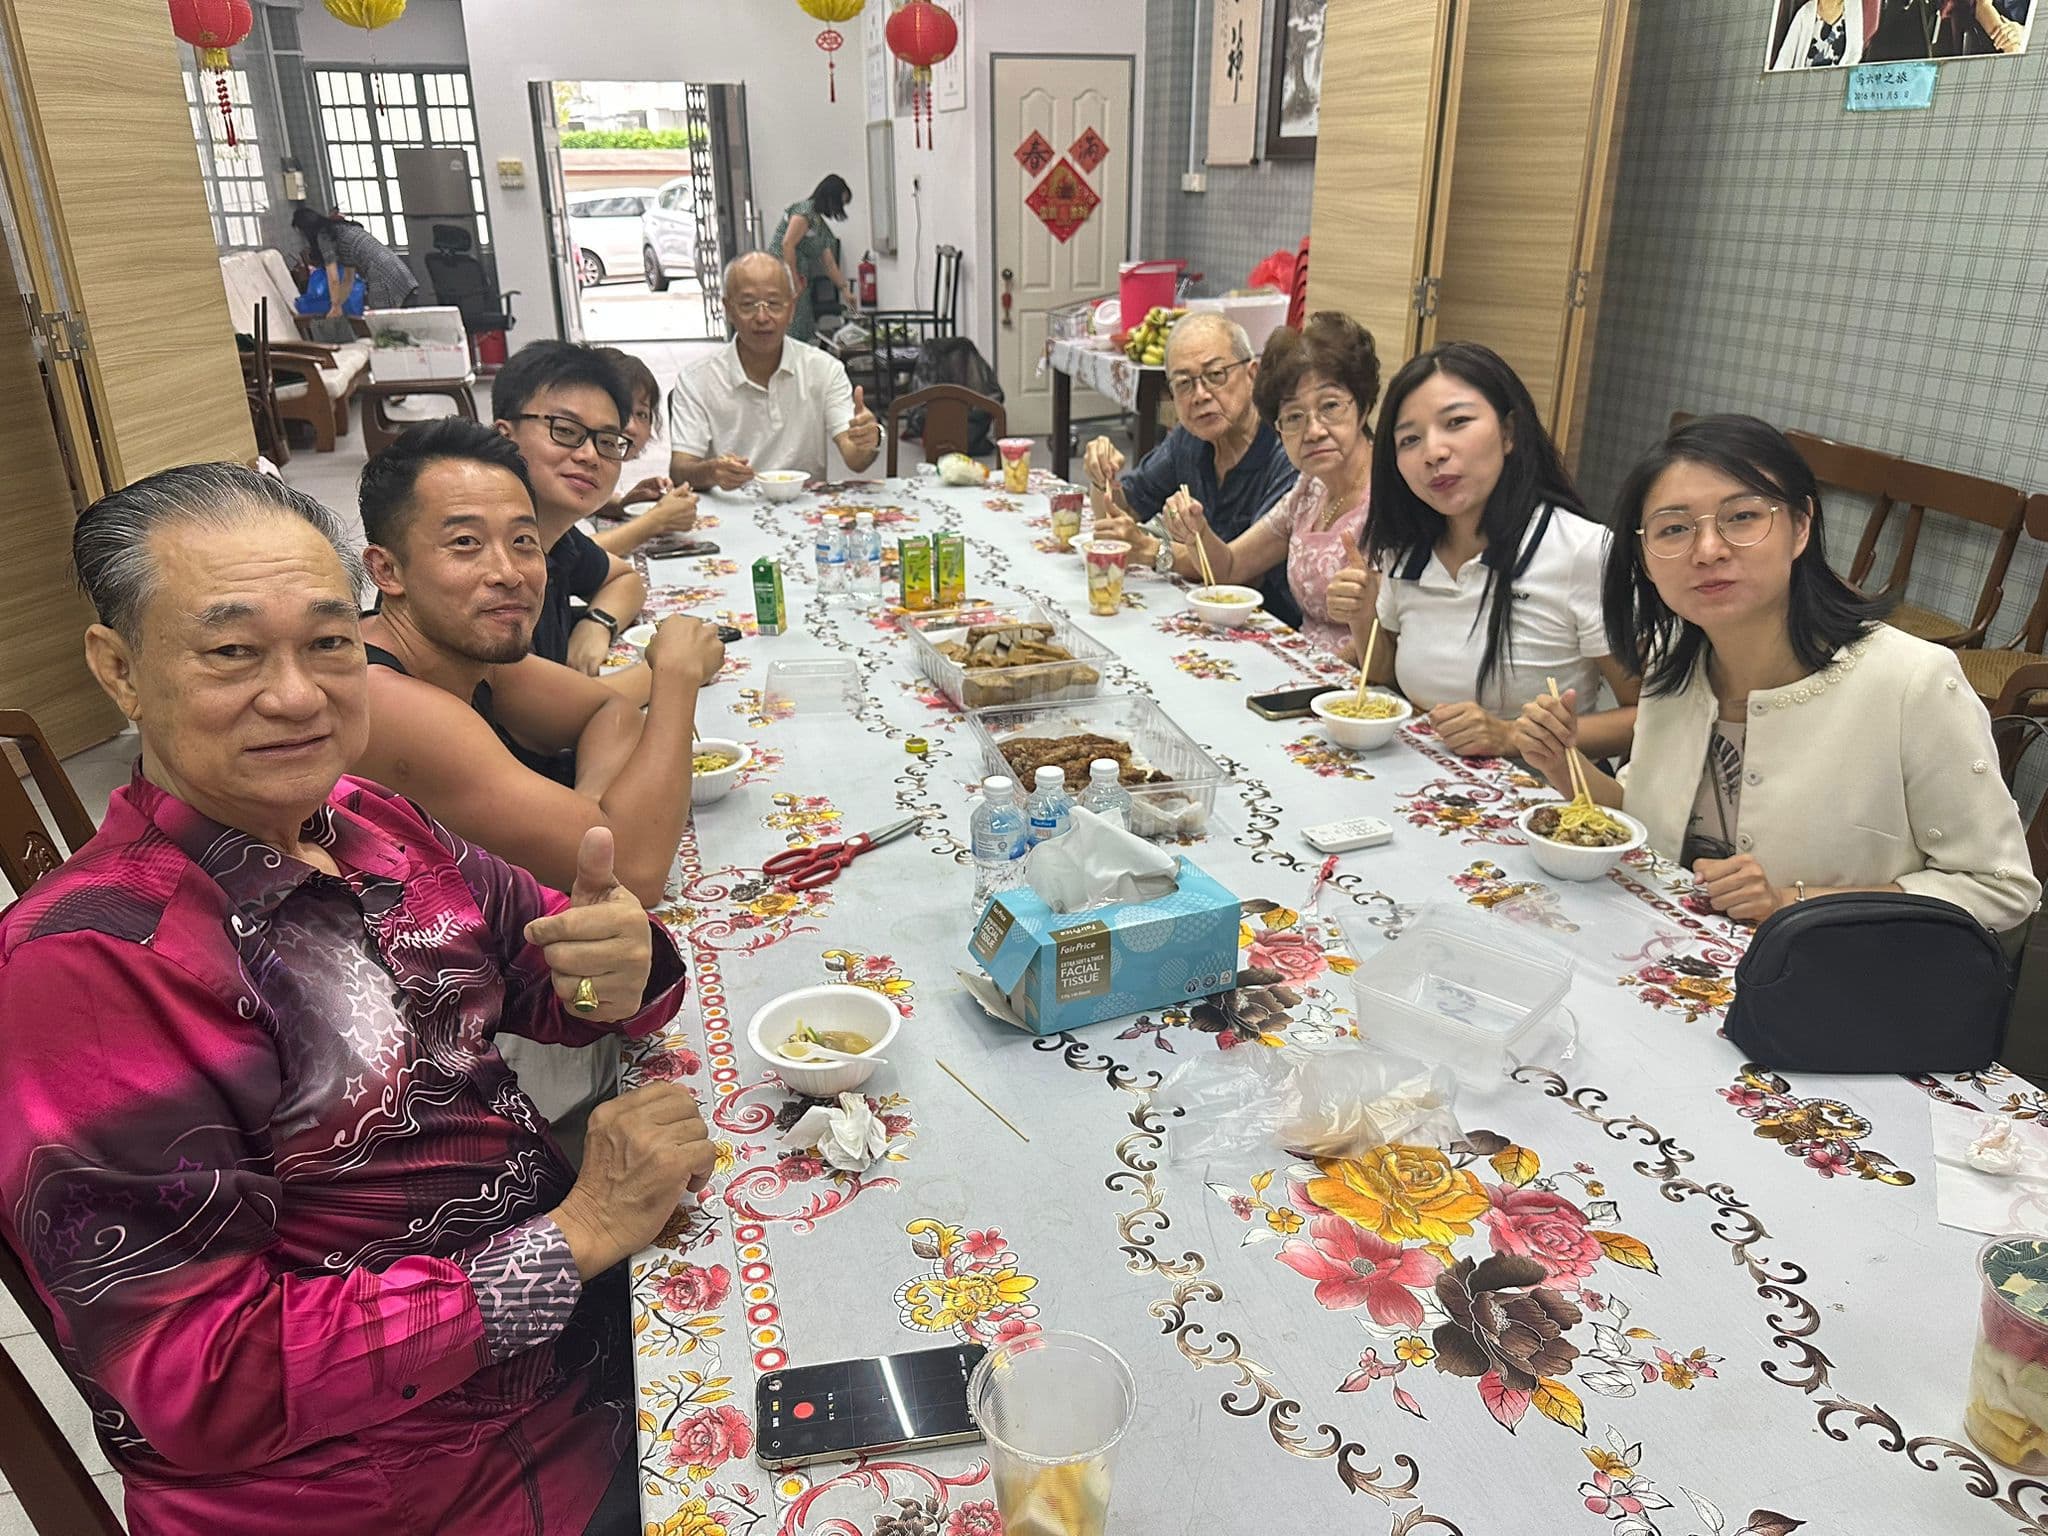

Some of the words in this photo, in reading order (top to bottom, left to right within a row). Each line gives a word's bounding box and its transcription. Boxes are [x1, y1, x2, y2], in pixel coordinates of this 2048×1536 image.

[1023, 138, 1049, 169] 春
[1060, 942, 1097, 955] FairPrice
[1060, 962, 1101, 978] FACIAL
[1060, 972, 1100, 988] TISSUE
